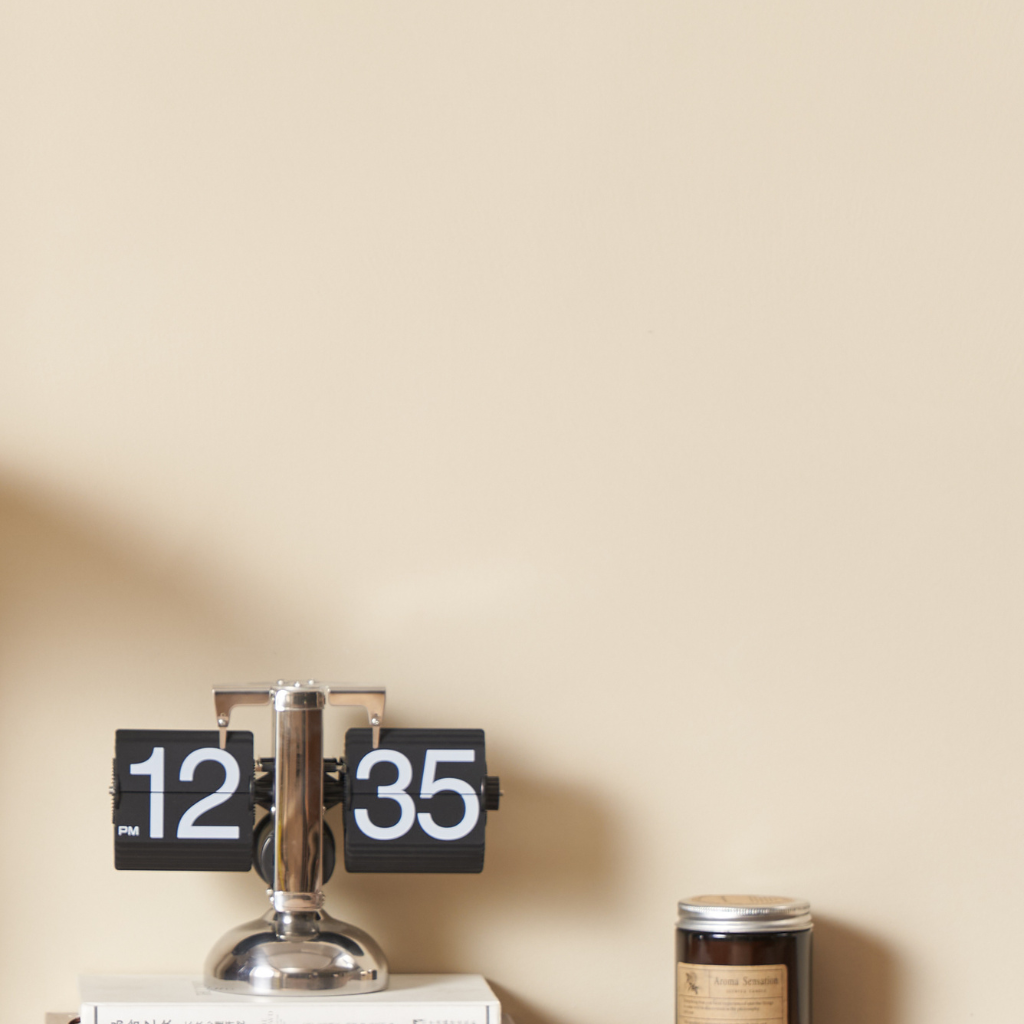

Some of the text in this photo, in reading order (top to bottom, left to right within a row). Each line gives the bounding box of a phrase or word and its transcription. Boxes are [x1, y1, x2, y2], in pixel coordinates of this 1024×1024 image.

[129, 747, 480, 841] 12 35
[117, 825, 140, 837] PM
